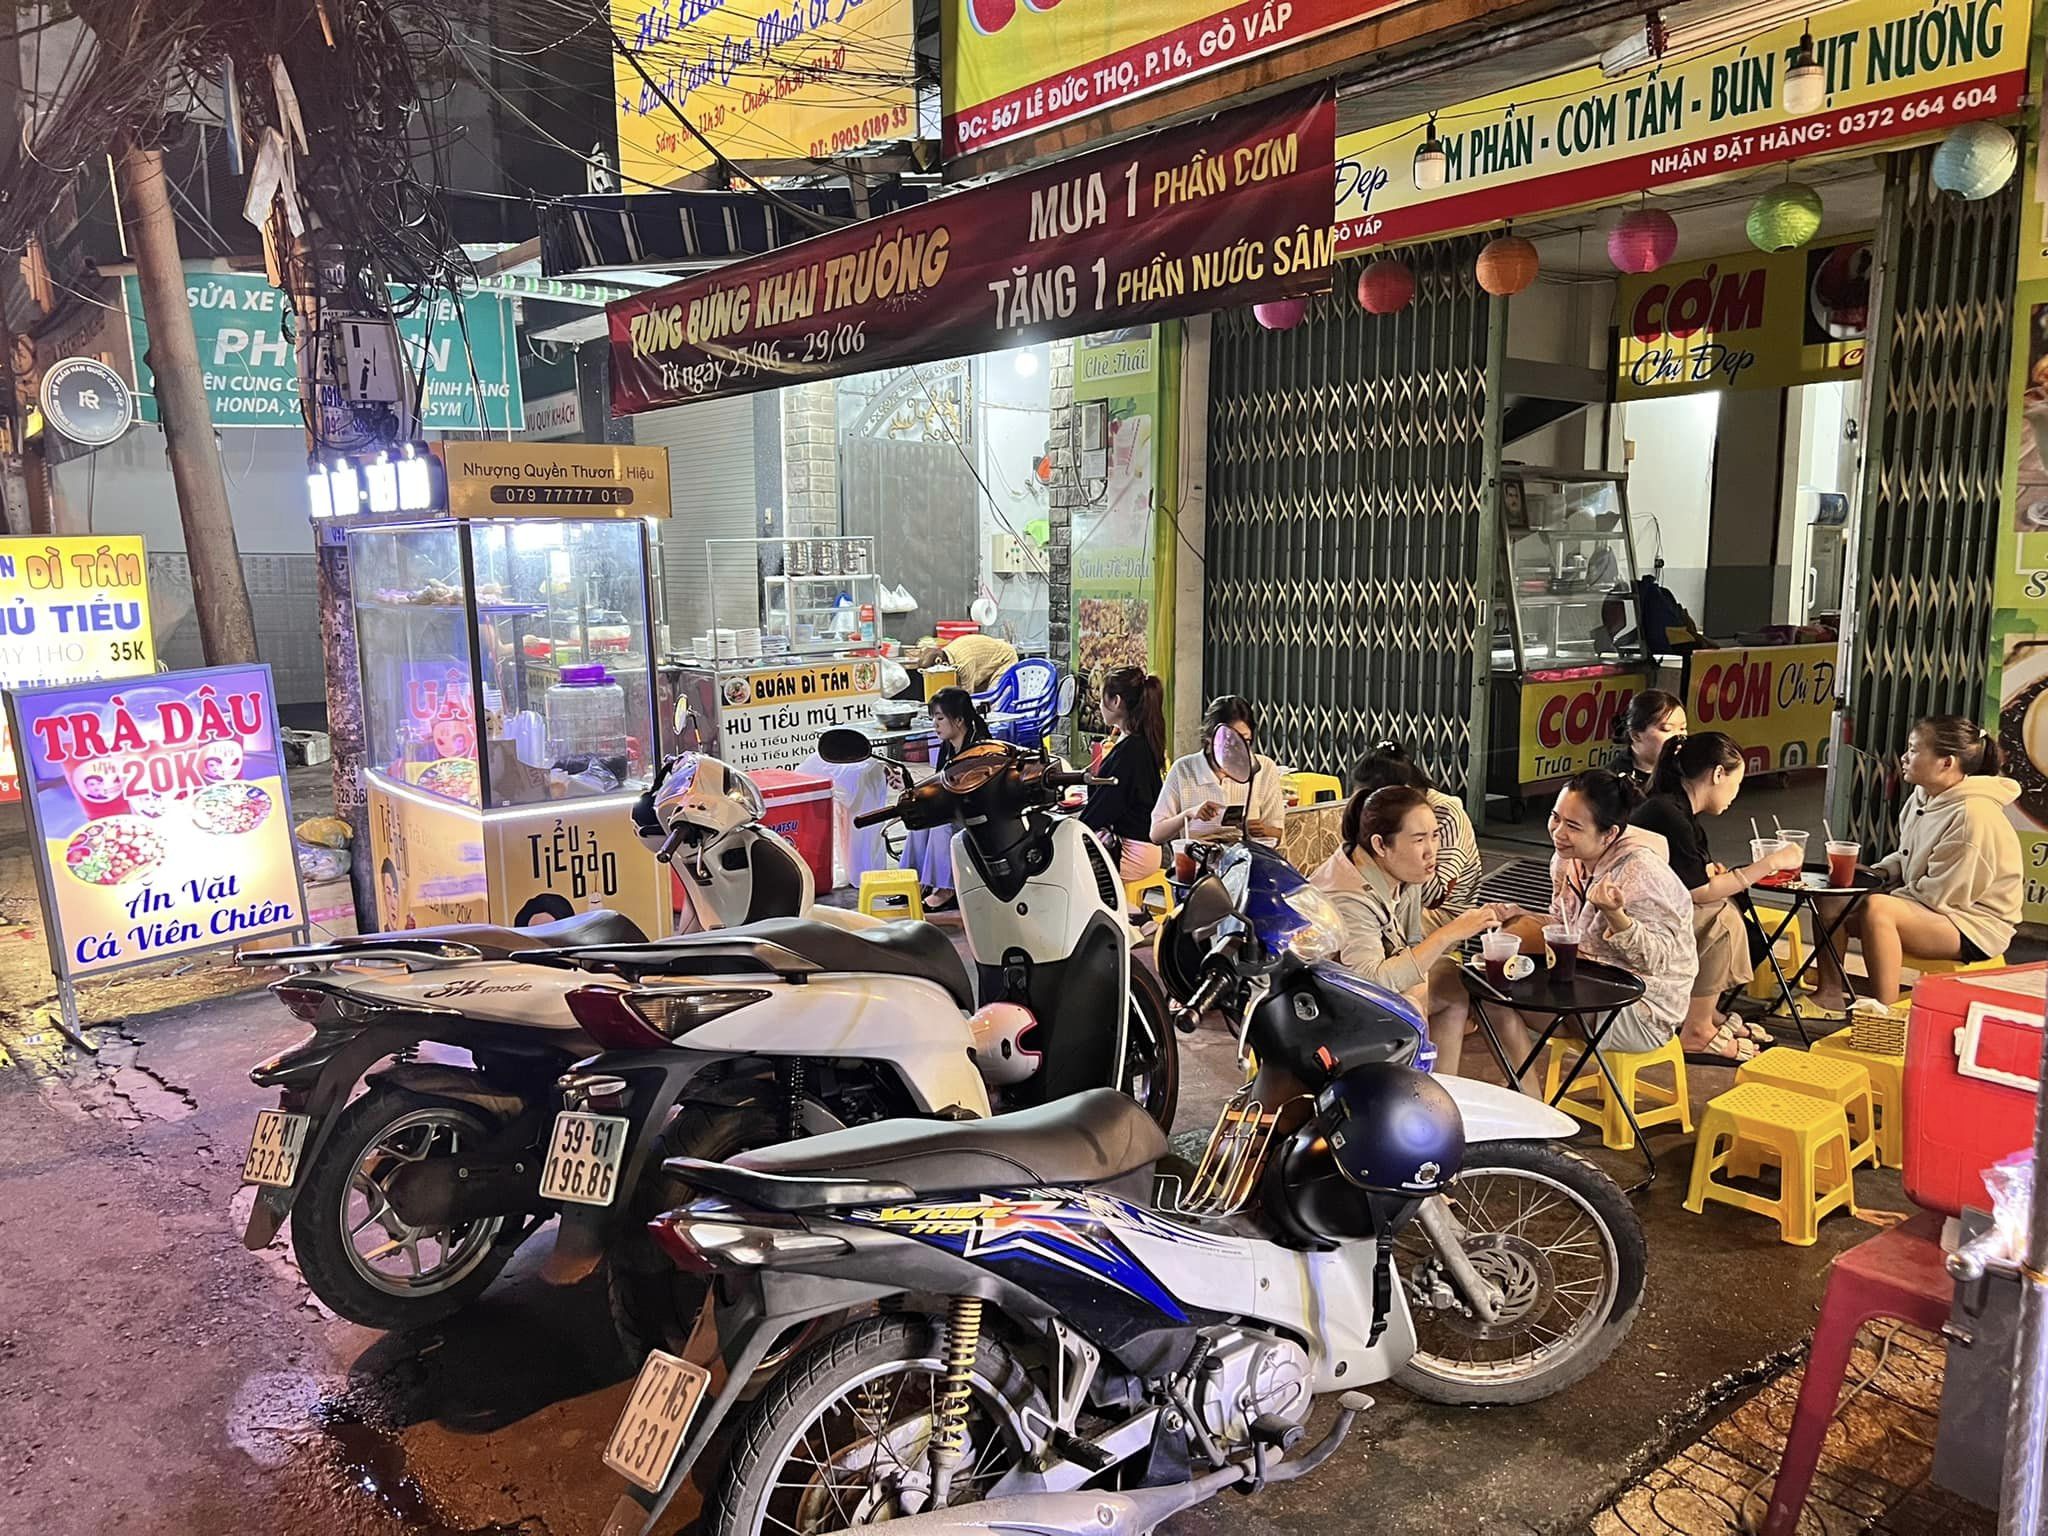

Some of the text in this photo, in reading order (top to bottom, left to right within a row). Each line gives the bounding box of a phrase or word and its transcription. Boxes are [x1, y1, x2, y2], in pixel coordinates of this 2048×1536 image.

[958, 0, 1292, 142] ĐC: 567 LÊ ĐỨC THỌ, P.16, GÒ VẤP
[831, 125, 859, 151] 0903
[862, 114, 889, 141] 6189
[892, 103, 908, 128] 33
[1335, 160, 1389, 211] Đẹp
[1469, 104, 1535, 179] PHẦN
[1557, 89, 1618, 157] CƠM
[1626, 66, 1685, 143] TẤM
[1709, 46, 1775, 122] BÚN
[1784, 30, 1860, 109] ỊT
[1866, 0, 2003, 86] NƯỚNG
[1650, 84, 1998, 180] NHẬN ĐẶT HÀNG: 0372 664 604
[1029, 132, 1298, 242] MUA 1 PHẦN CƠM
[1353, 215, 1383, 240] VẤP
[187, 281, 236, 310] SỬA
[242, 291, 275, 312] XE
[754, 264, 819, 329] KHAI
[823, 226, 950, 313] TRƯƠNG
[988, 223, 1336, 336] TẶNG 1 PHẦN NƯỚC SÂM
[1631, 263, 1767, 343] CƠM
[682, 352, 726, 394] ngày
[802, 320, 866, 364] 29/06
[1631, 341, 1756, 387] Chị Đẹp
[215, 396, 285, 417] HONDA,
[230, 376, 282, 392] CUNG
[424, 379, 462, 397] HÍNH
[463, 462, 520, 480] Nhượng
[525, 459, 568, 480] Quyền
[626, 465, 655, 480] Hiệu
[505, 488, 537, 502] 079
[544, 488, 594, 502] 77777
[71, 544, 142, 588] TÁM
[50, 594, 142, 634] TIẾU
[110, 641, 146, 662] 35K
[755, 671, 796, 699] QUÁN
[821, 667, 850, 693] TÁM
[1697, 651, 1772, 724] CƠM
[1778, 662, 1808, 710] Chị
[35, 696, 147, 762] TRÀ
[157, 684, 264, 747] DÂU
[725, 710, 751, 736] HỦ
[759, 704, 799, 732] TIẾU
[1537, 681, 1634, 749] CƠM
[740, 737, 757, 751] Hủ
[761, 733, 788, 749] Tiếu
[741, 753, 757, 765] Hủ
[761, 749, 789, 764] Tiếu
[123, 750, 202, 800] 20K
[1534, 754, 1571, 777] Trưa
[126, 874, 241, 919] Ăn Vặt
[76, 900, 295, 965] Cá Viên Chiên
[480, 982, 533, 994] mode
[246, 1146, 295, 1183] 532.63
[548, 1156, 614, 1198] 196.86
[615, 1411, 670, 1477] 4331
